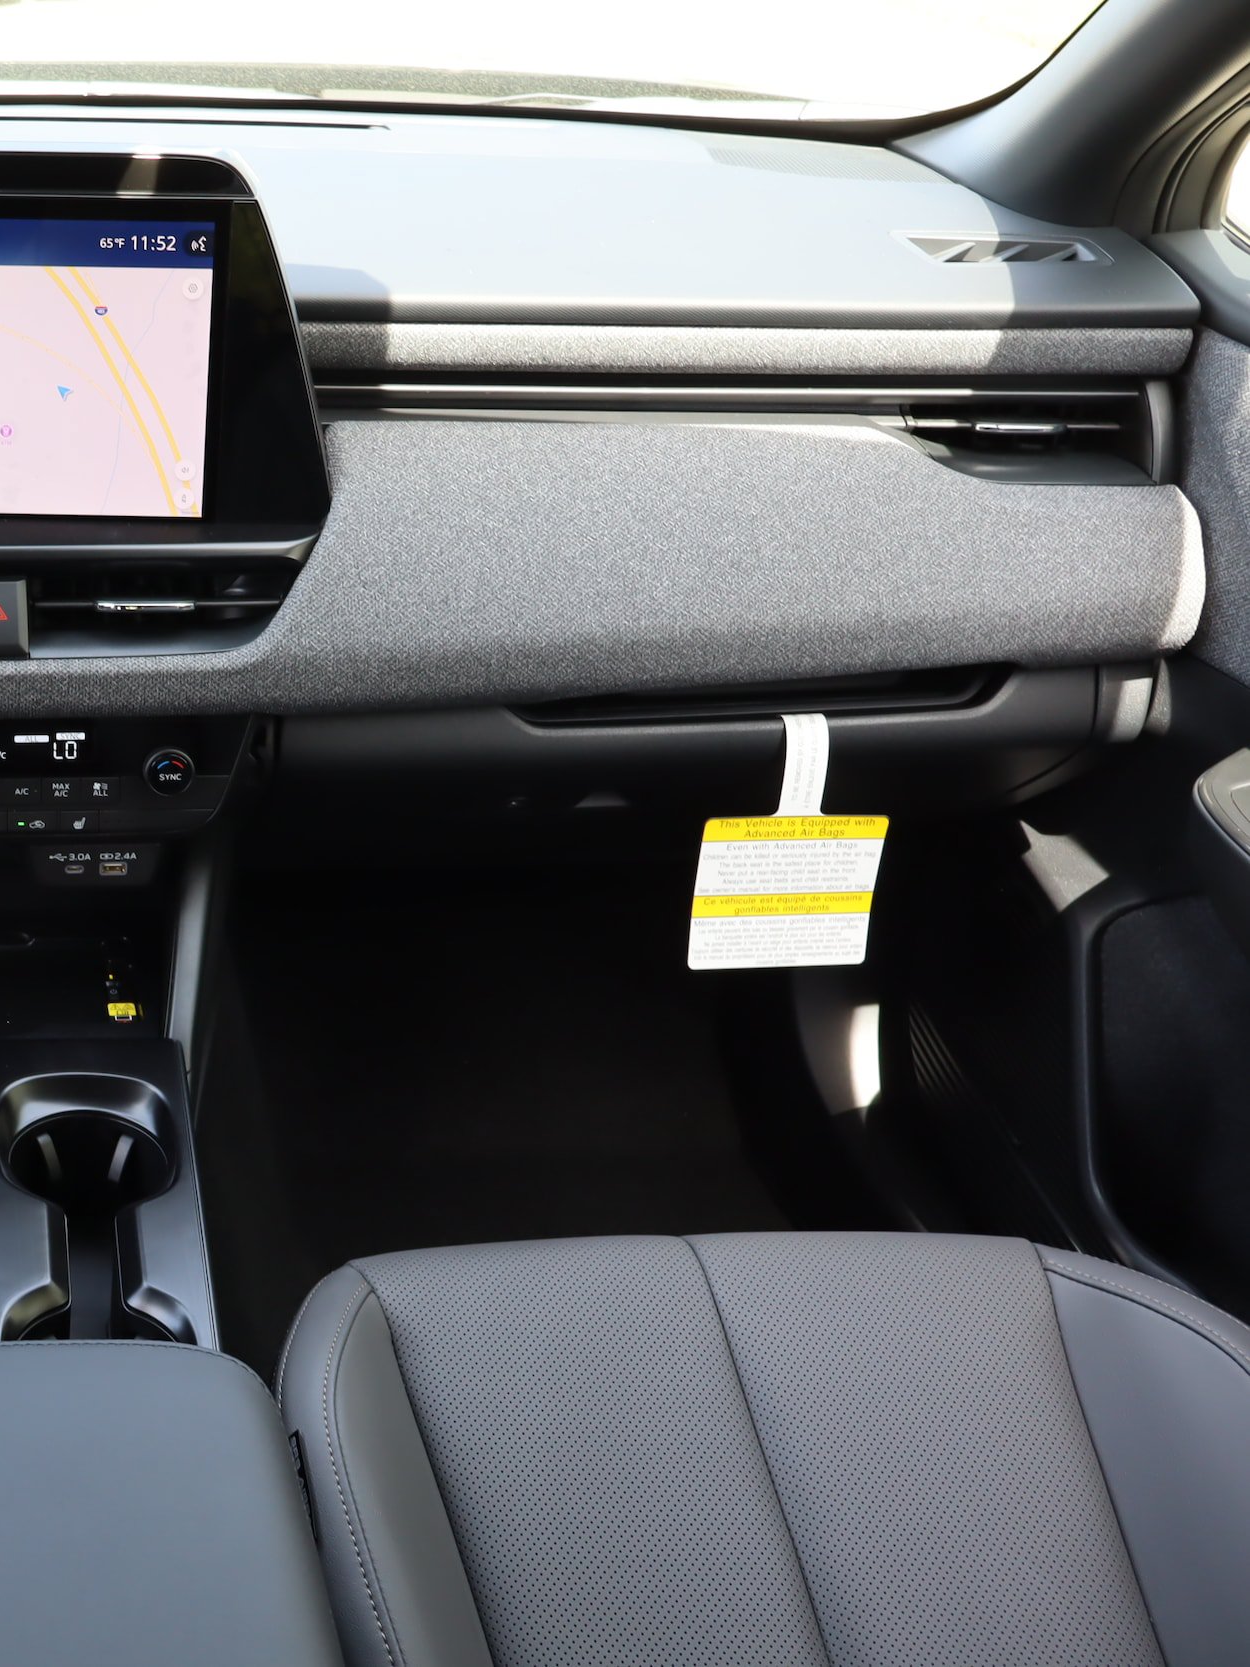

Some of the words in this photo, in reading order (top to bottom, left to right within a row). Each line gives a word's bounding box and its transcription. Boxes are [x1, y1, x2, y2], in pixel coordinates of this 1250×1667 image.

[131, 235, 177, 251] 11:52
[53, 740, 77, 760] LO
[159, 773, 182, 781] SYNC
[14, 788, 29, 796] A/C
[719, 819, 740, 829] This
[745, 818, 783, 828] Vehicle
[787, 818, 796, 827] is
[800, 817, 850, 829] Equipped
[854, 817, 876, 827] with
[744, 828, 796, 838] Advanced
[800, 828, 815, 837] Air
[818, 828, 845, 839] Bags
[726, 843, 749, 852] Even
[751, 842, 770, 851] with
[773, 841, 817, 851] Advanced
[820, 841, 832, 850] Air
[836, 841, 858, 850] Bags
[68, 852, 91, 861] 3.0A
[114, 852, 137, 860] 2.4A
